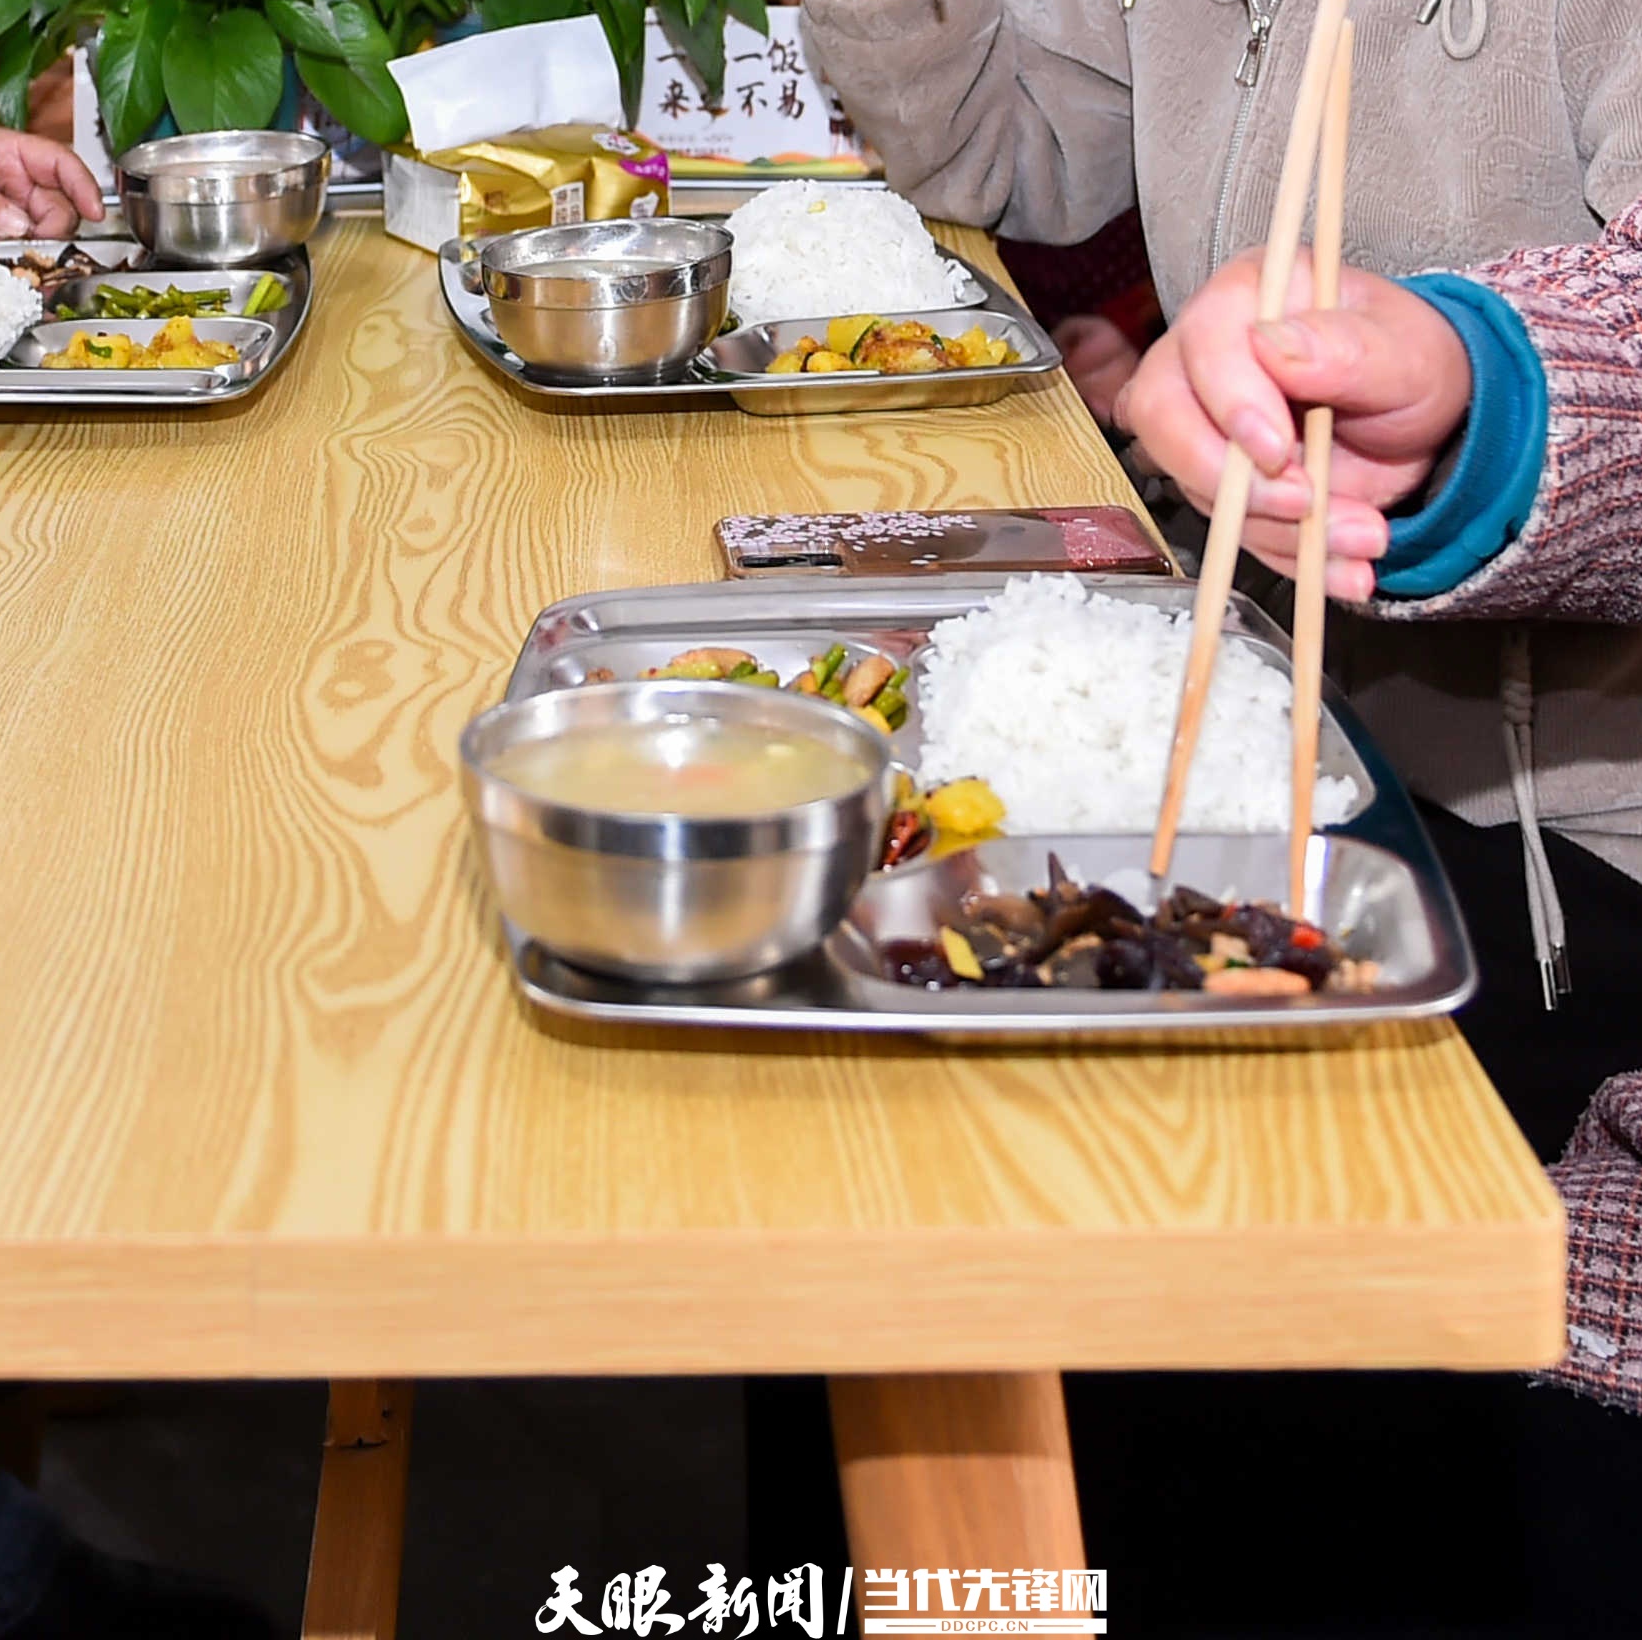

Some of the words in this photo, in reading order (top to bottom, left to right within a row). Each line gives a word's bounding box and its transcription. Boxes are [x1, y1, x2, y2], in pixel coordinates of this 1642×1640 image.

[657, 39, 805, 75] 一一饭
[659, 79, 805, 120] 来不易
